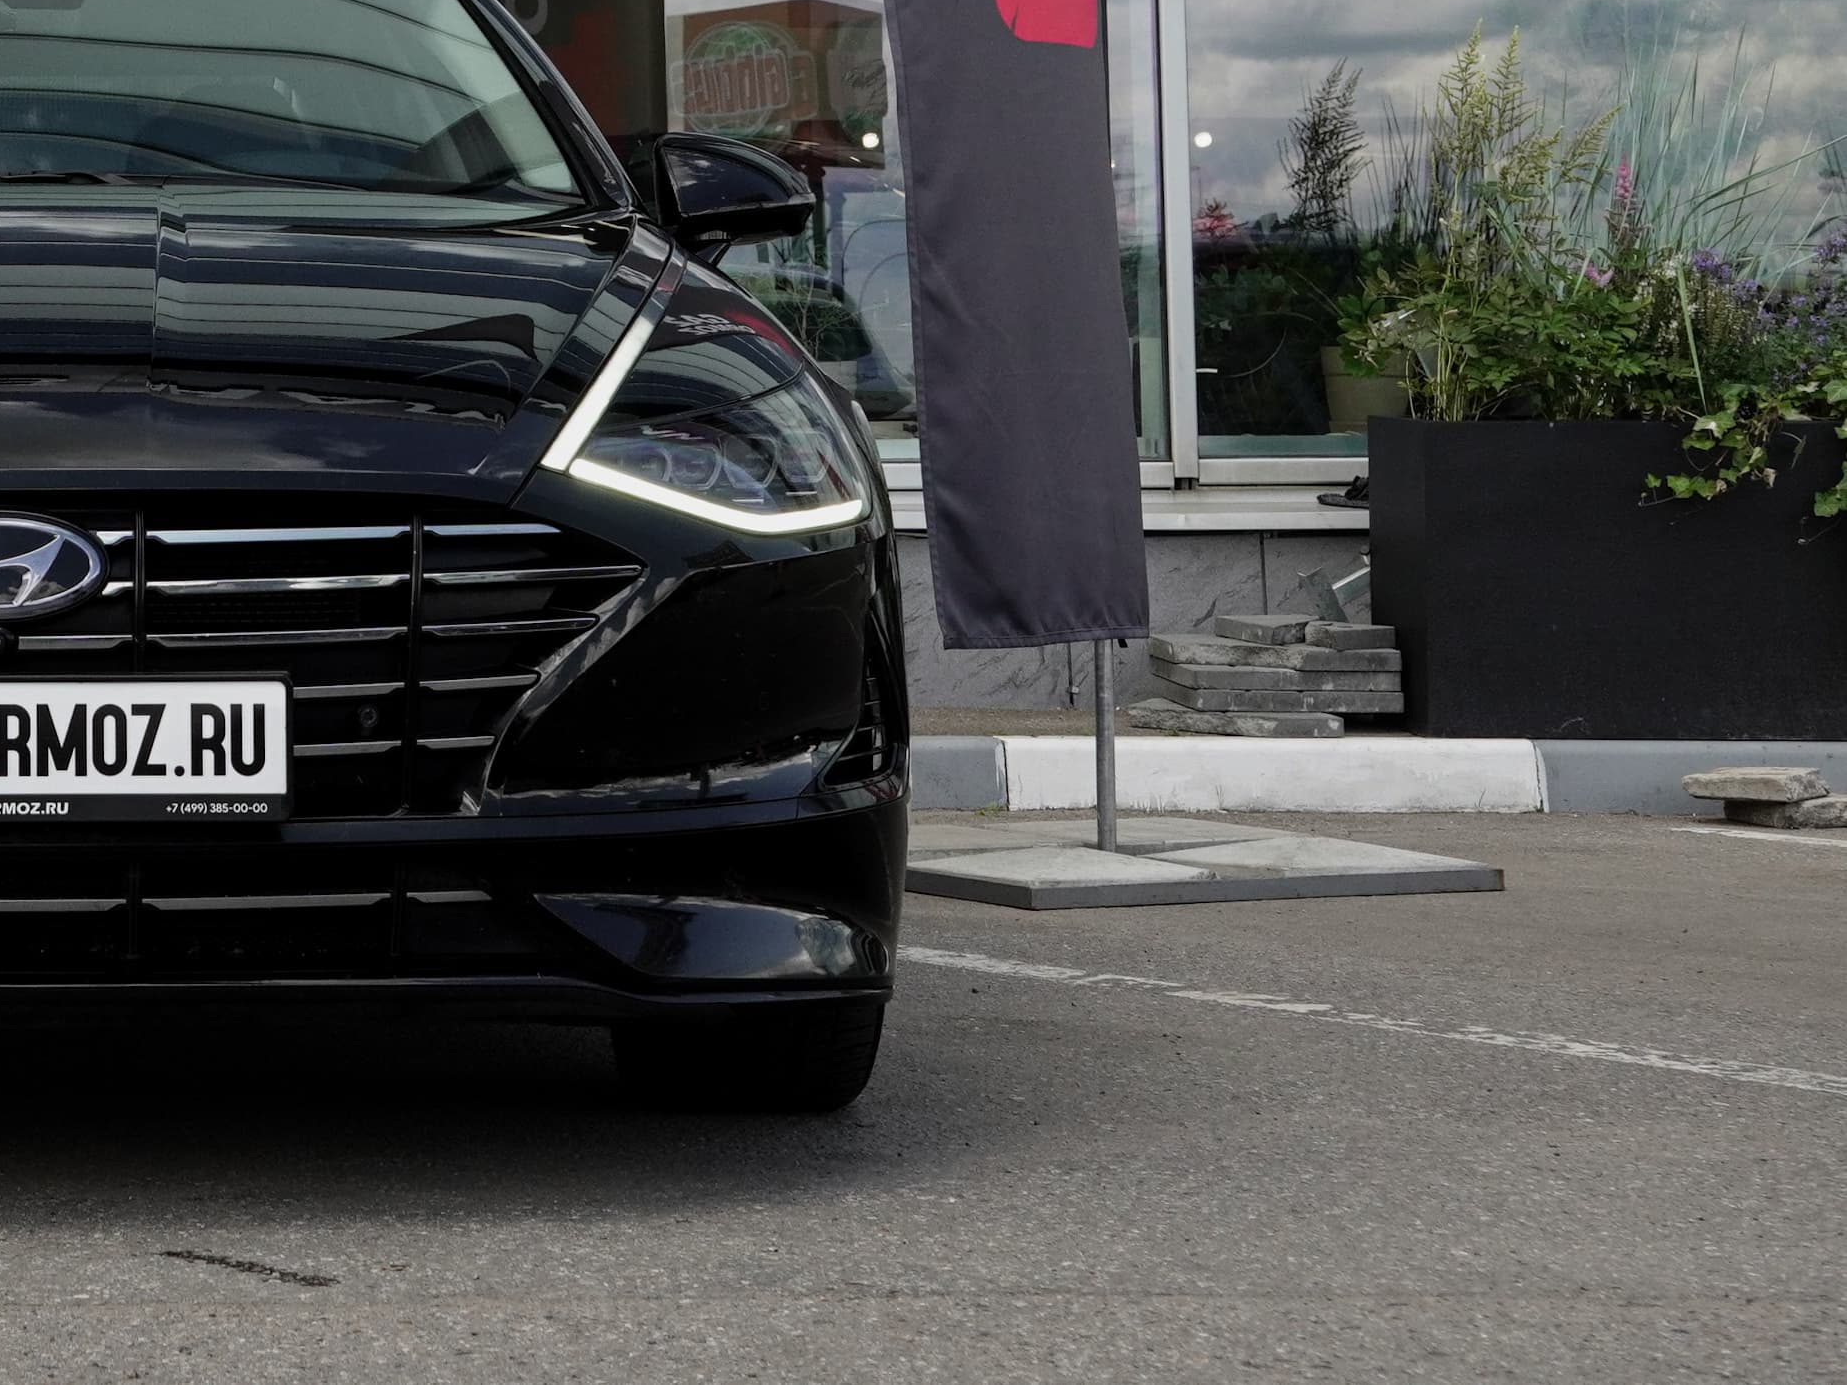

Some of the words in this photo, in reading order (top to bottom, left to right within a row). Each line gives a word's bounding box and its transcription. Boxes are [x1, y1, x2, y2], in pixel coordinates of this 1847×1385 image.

[166, 803, 178, 813] +7
[181, 802, 207, 815] (499)
[210, 803, 268, 814] 385-00-00
